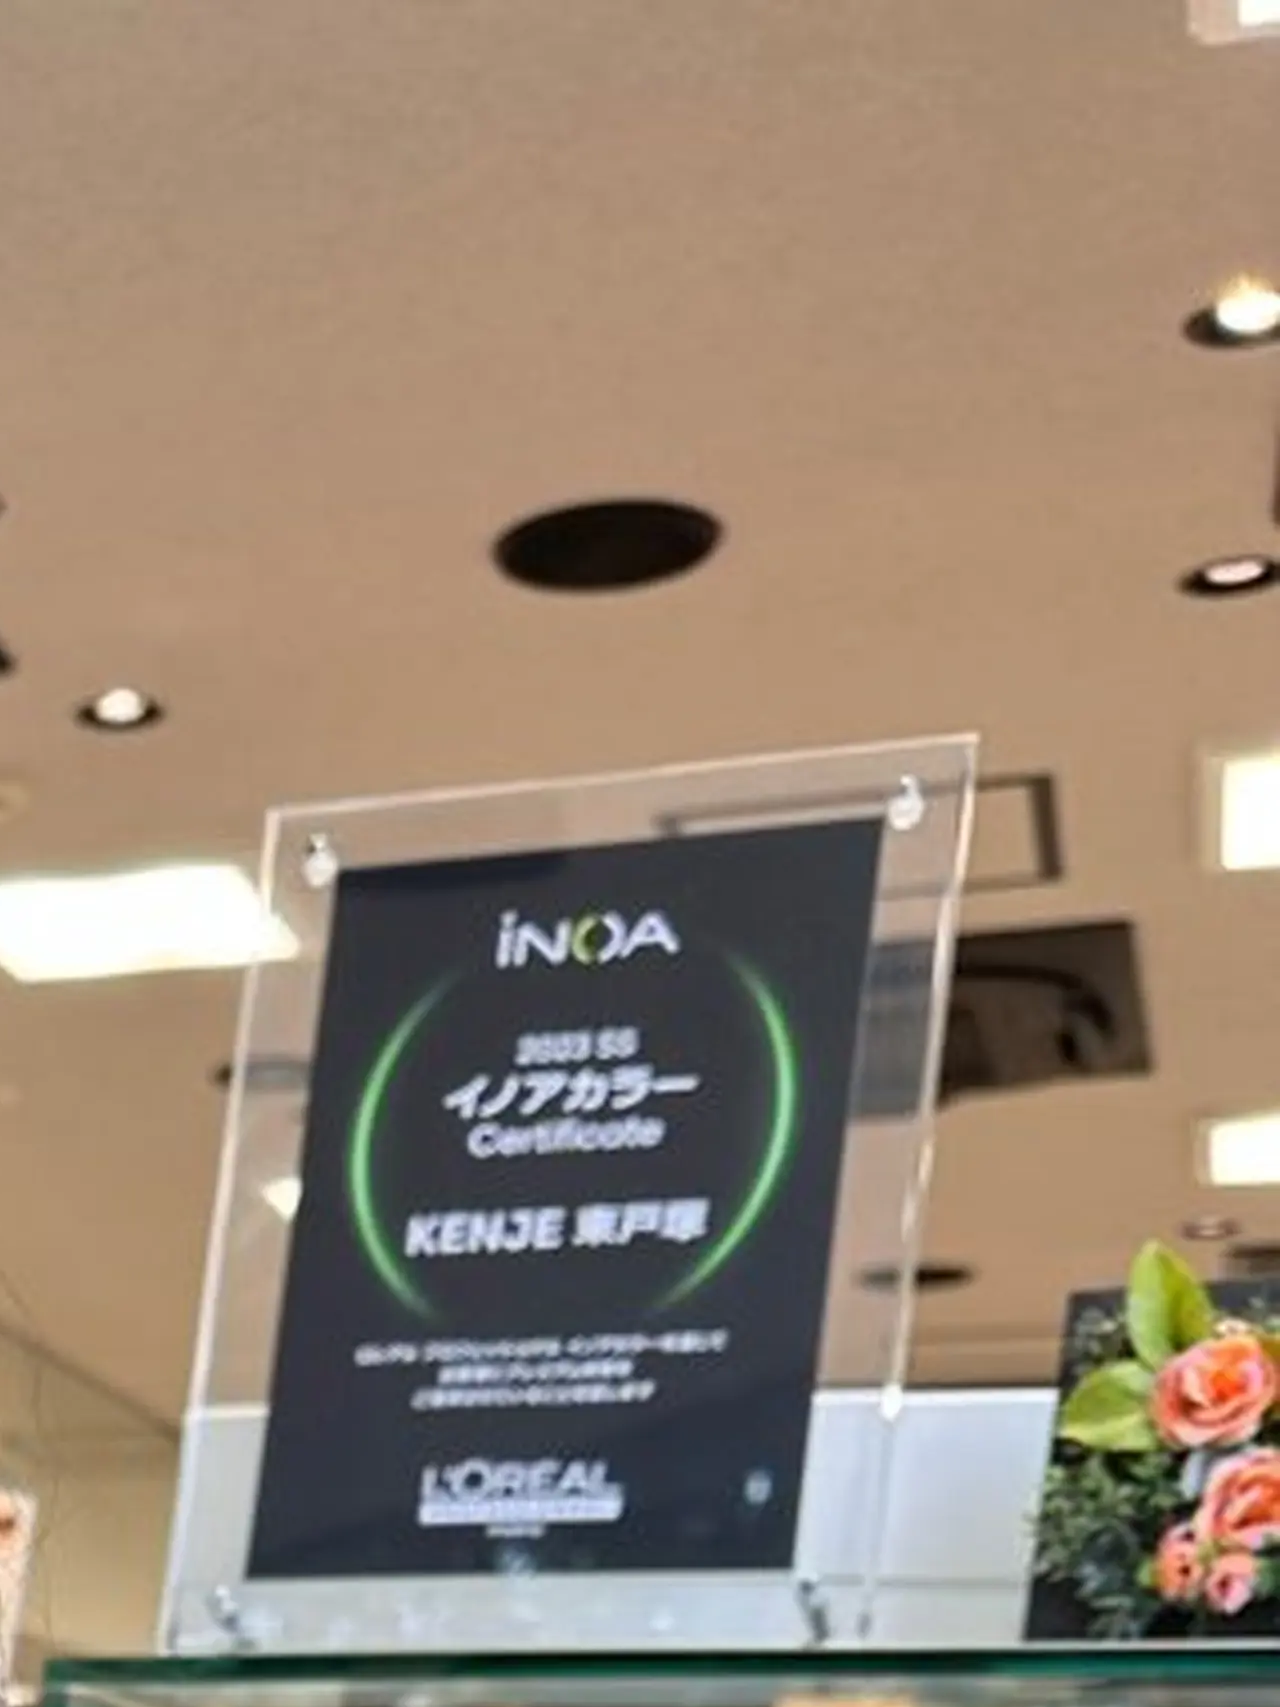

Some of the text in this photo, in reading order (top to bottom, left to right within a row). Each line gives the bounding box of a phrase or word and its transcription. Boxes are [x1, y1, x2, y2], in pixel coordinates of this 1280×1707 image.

[441, 1063, 702, 1121] イノアカラー
[466, 1115, 667, 1159] Certificate
[404, 1206, 568, 1258] KENJE
